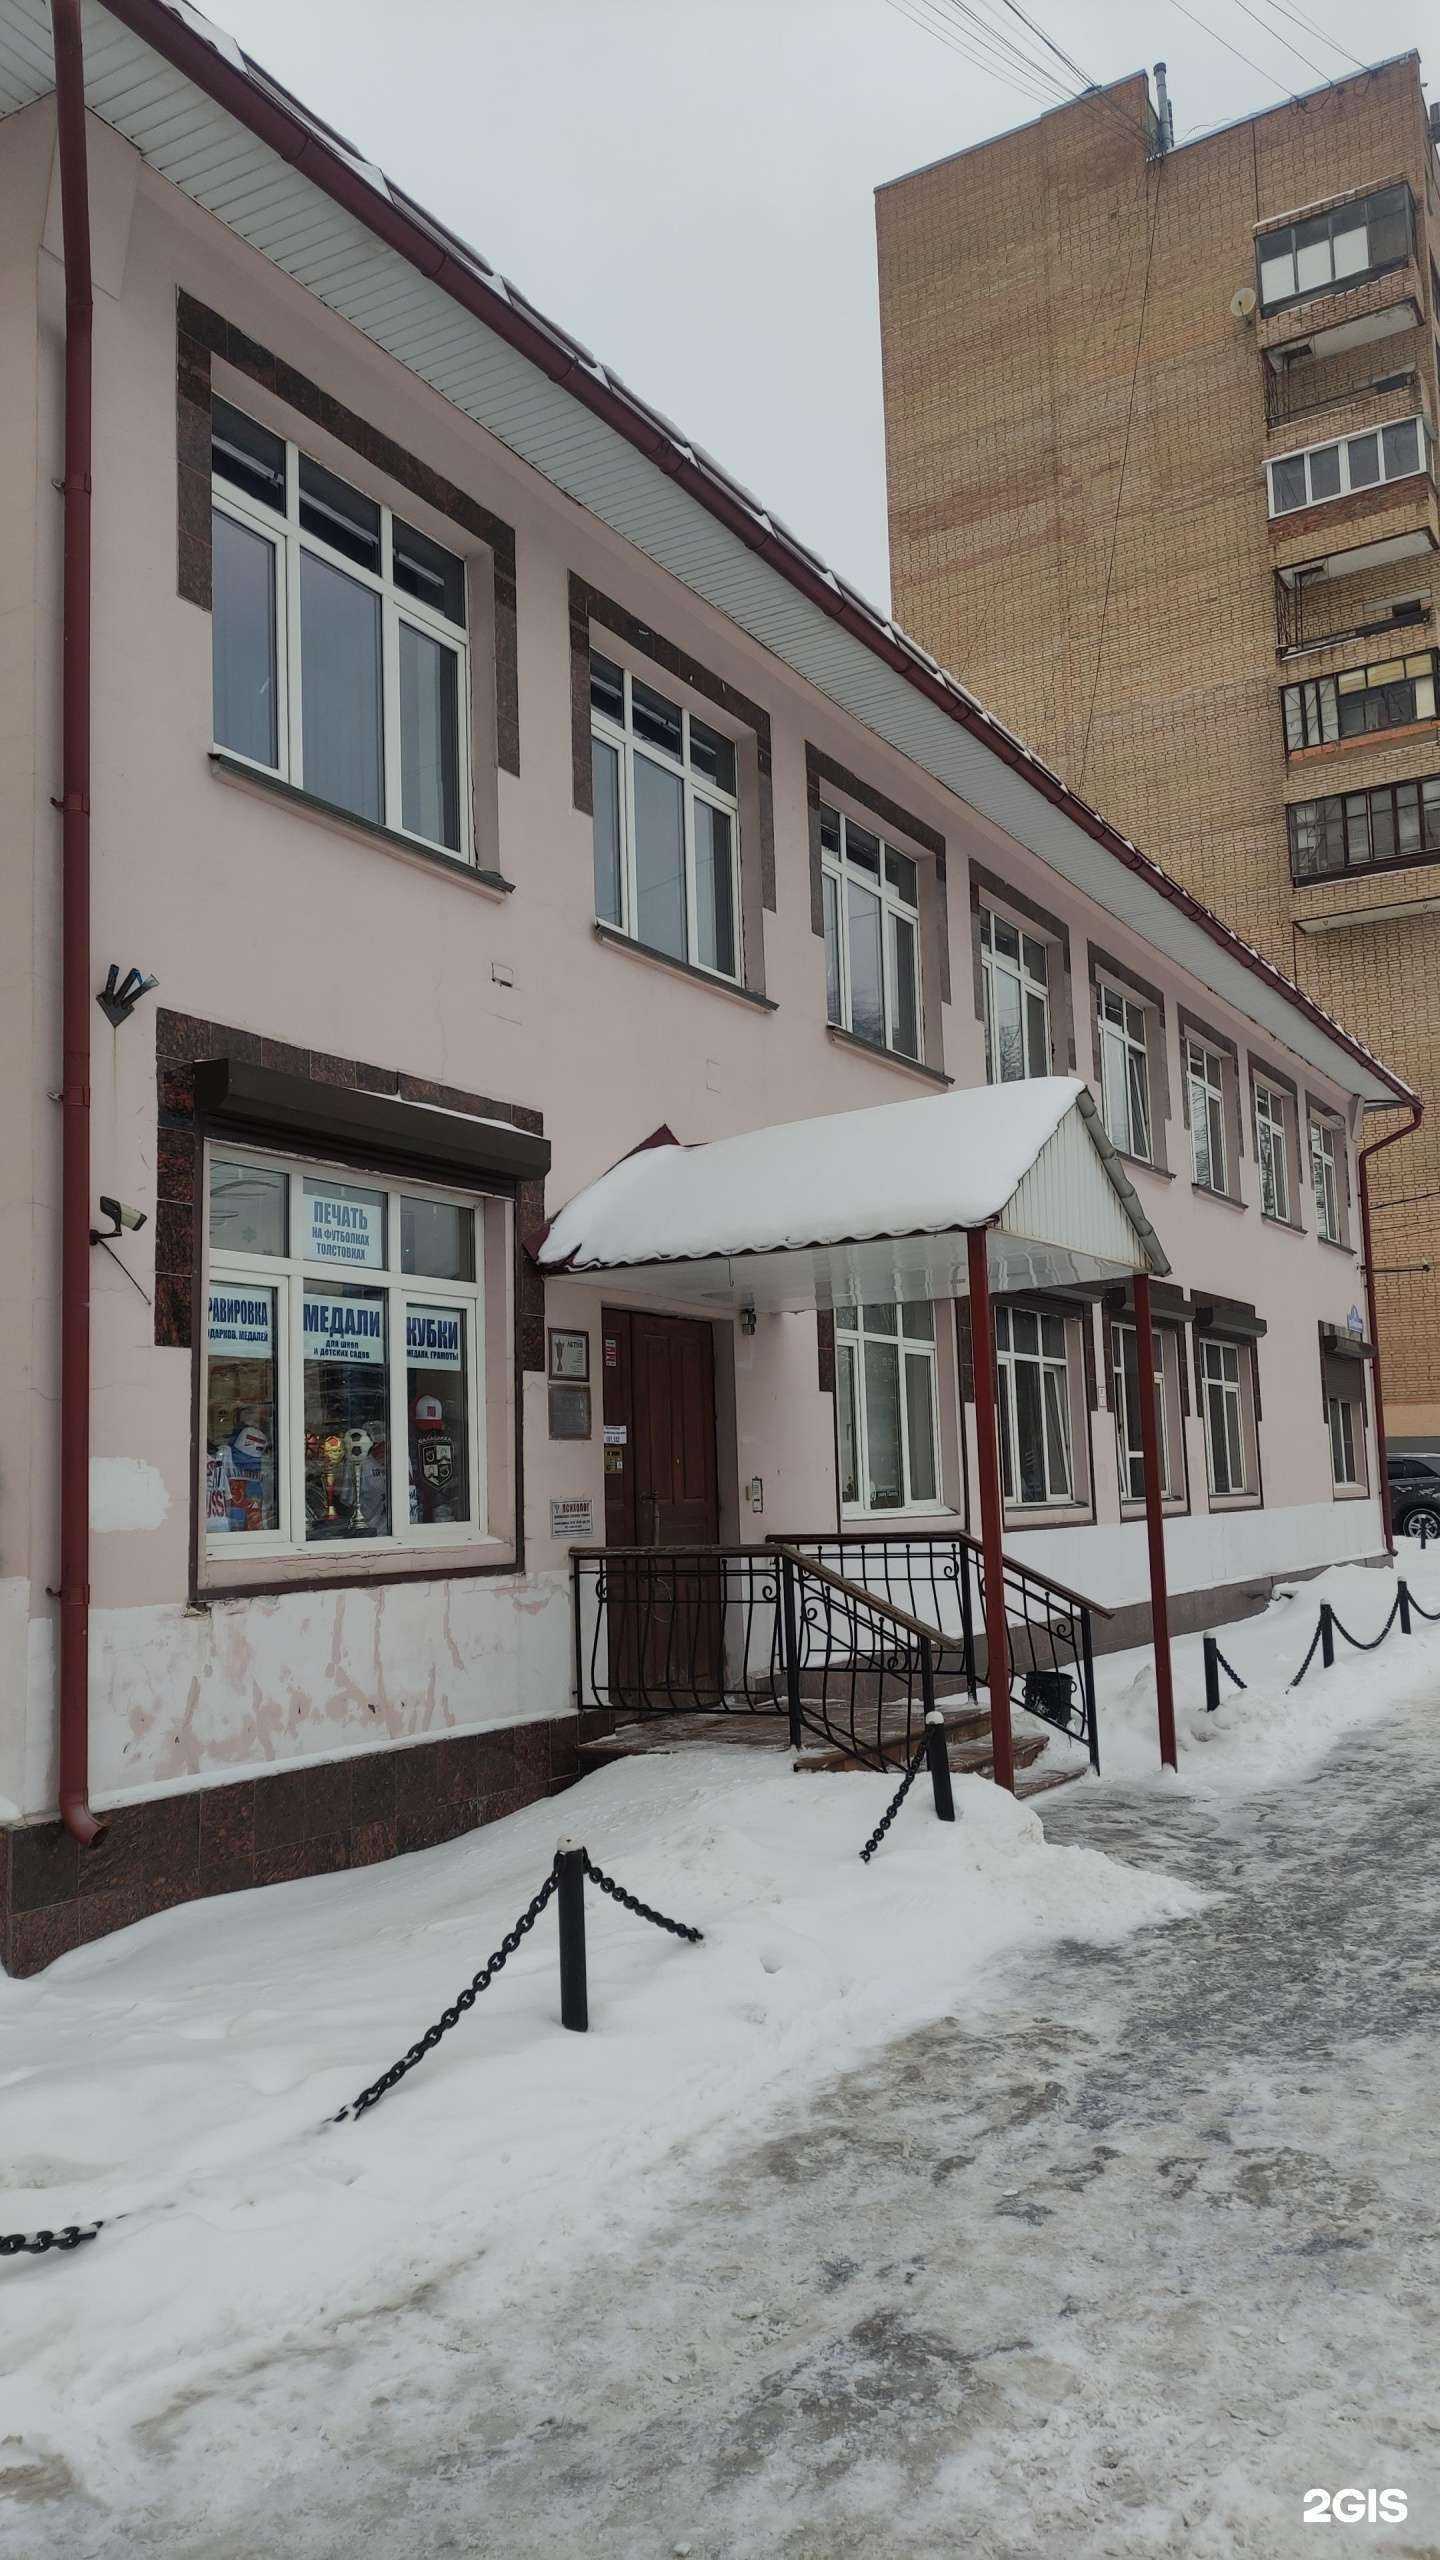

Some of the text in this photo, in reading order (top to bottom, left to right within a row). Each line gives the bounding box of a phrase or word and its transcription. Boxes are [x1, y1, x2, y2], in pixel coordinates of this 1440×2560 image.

[313, 1201, 368, 1230] ПЕЧАТЬ
[312, 1226, 370, 1246] НА ФУТБОЛКАХ
[316, 1243, 366, 1260] ТОЛСТОВКАХ
[303, 1304, 379, 1339] МЕДАЛИ
[407, 1317, 458, 1350] КУБКИ
